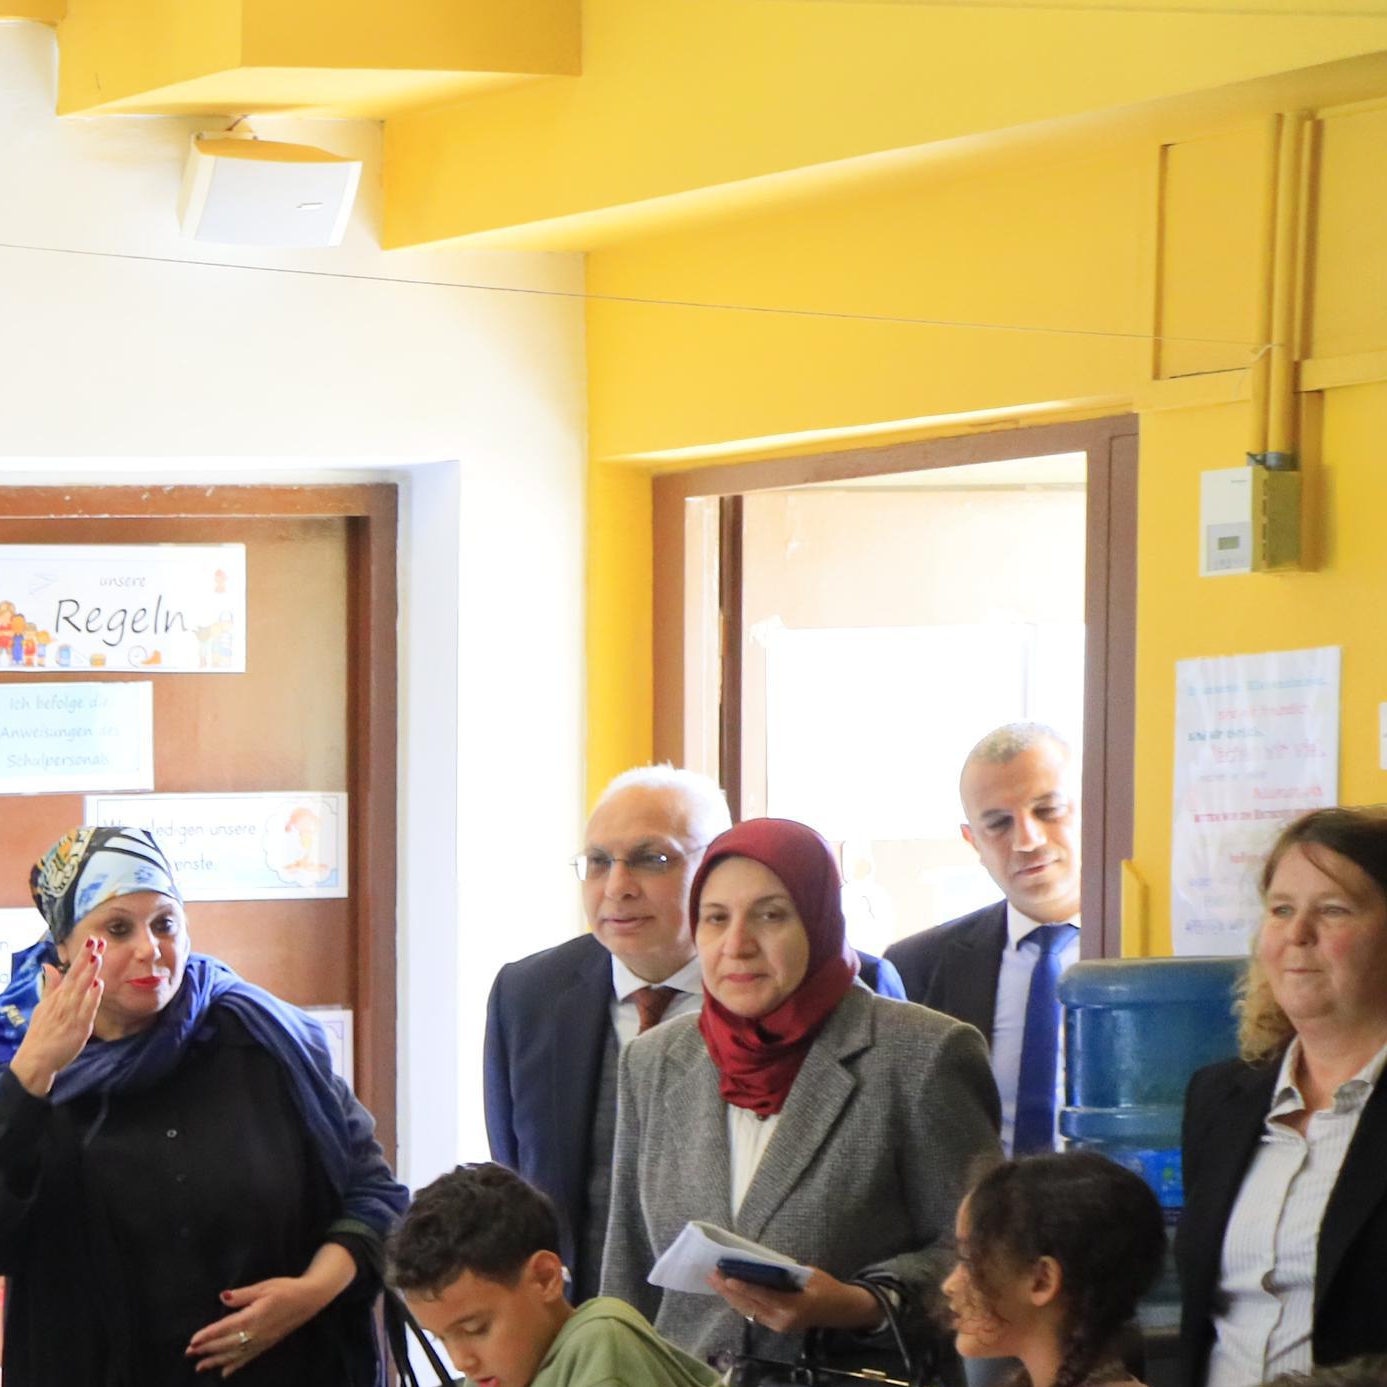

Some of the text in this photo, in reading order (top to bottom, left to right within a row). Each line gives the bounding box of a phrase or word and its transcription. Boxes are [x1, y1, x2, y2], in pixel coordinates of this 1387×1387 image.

[99, 575, 147, 588] unsere
[55, 594, 188, 647] Regeln
[35, 694, 84, 714] befolge
[0, 727, 94, 743] Anweisungen
[209, 822, 257, 837] unsere
